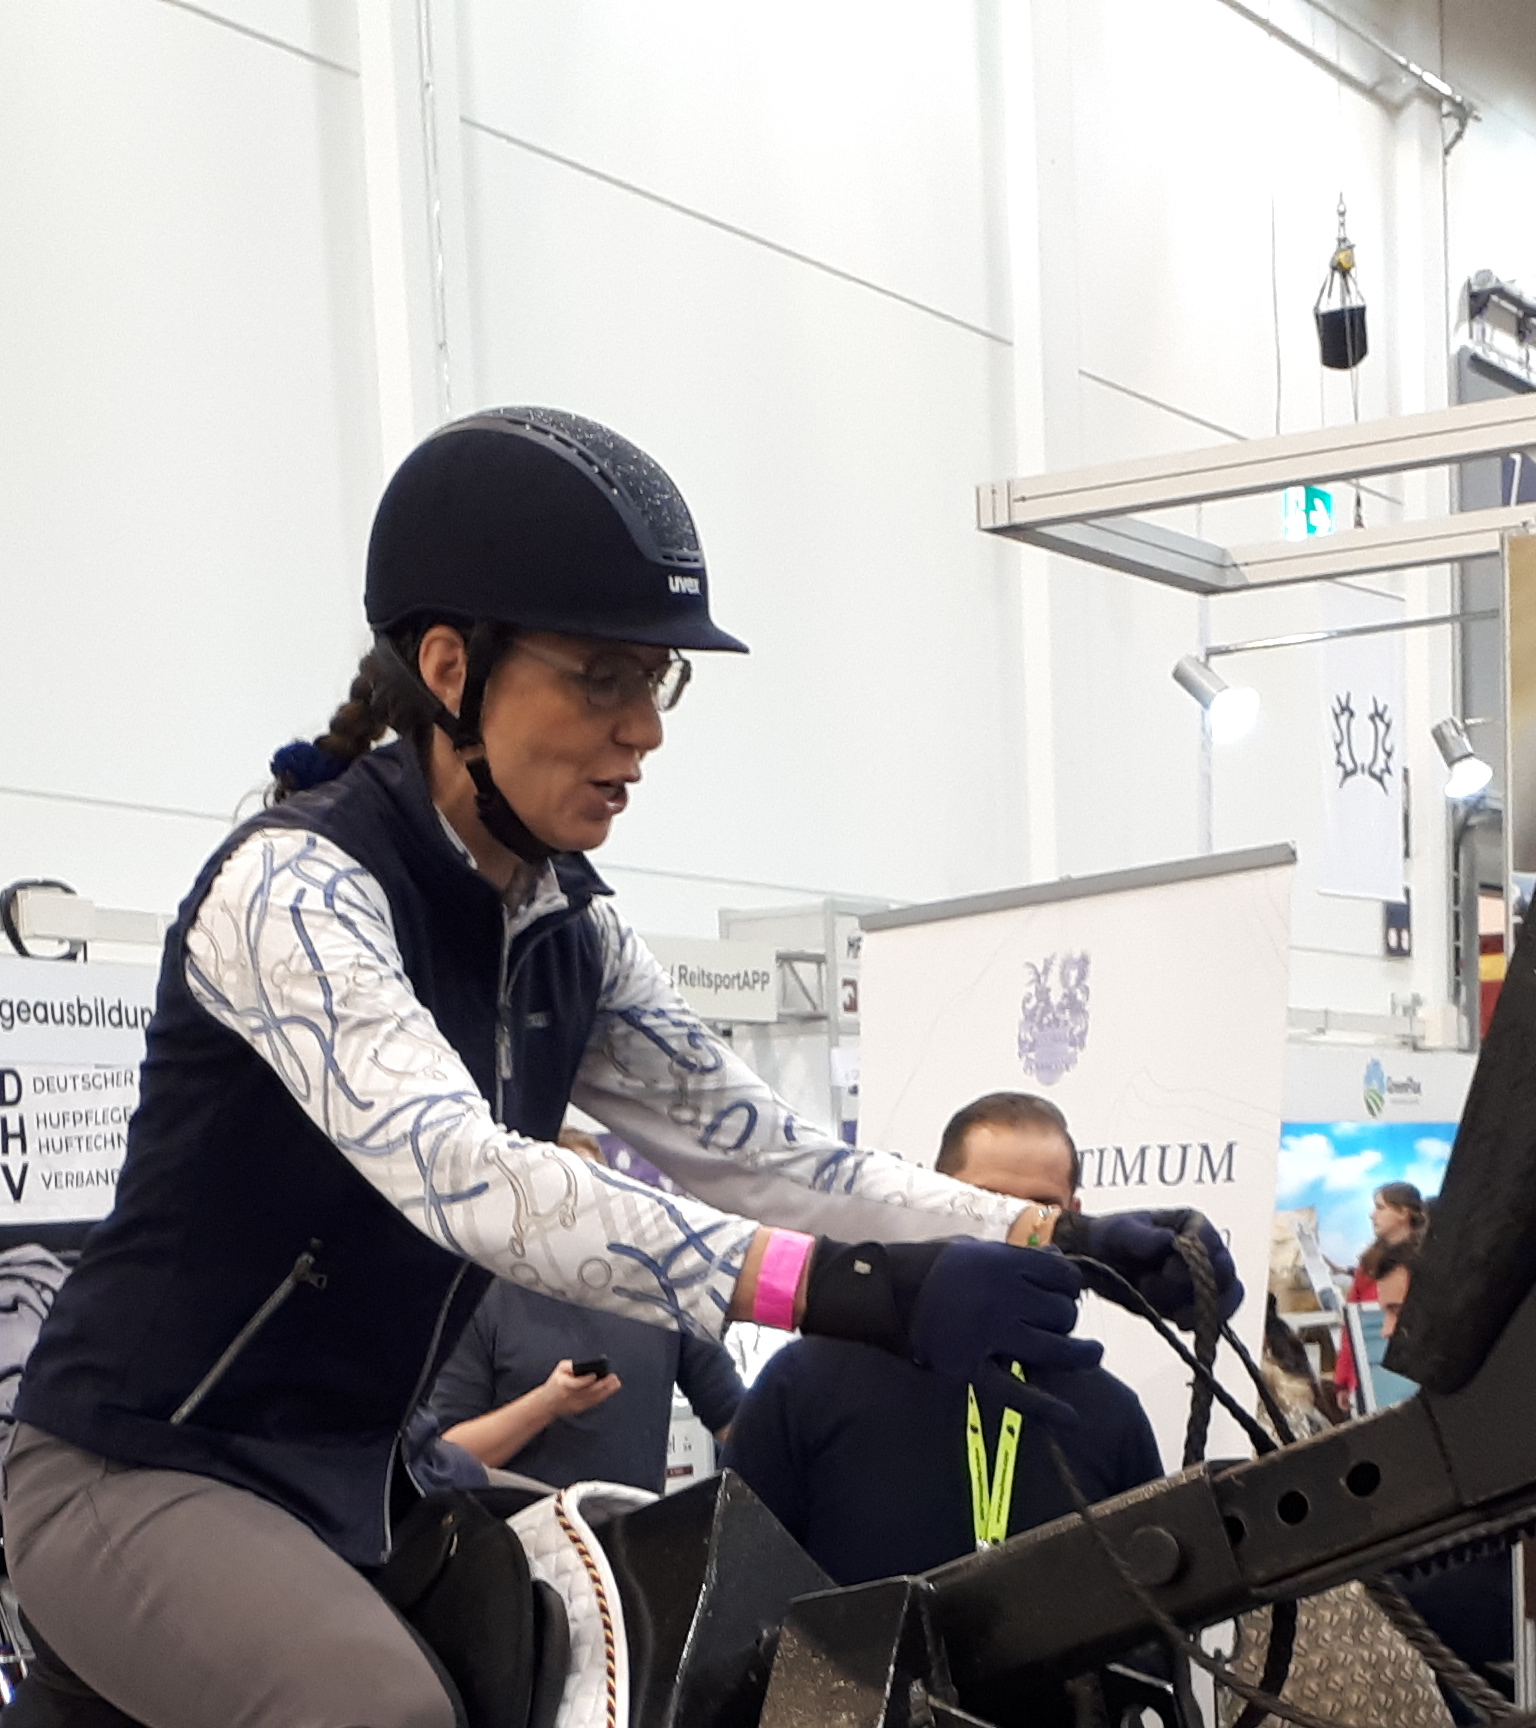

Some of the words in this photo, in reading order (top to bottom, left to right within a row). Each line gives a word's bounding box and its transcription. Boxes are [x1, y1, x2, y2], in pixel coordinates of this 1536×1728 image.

[667, 574, 701, 596] uvex
[678, 963, 771, 995] ReitsportAPP
[32, 1070, 135, 1094] DEUTSCHER
[0, 1113, 27, 1155] H
[0, 1162, 29, 1203] V
